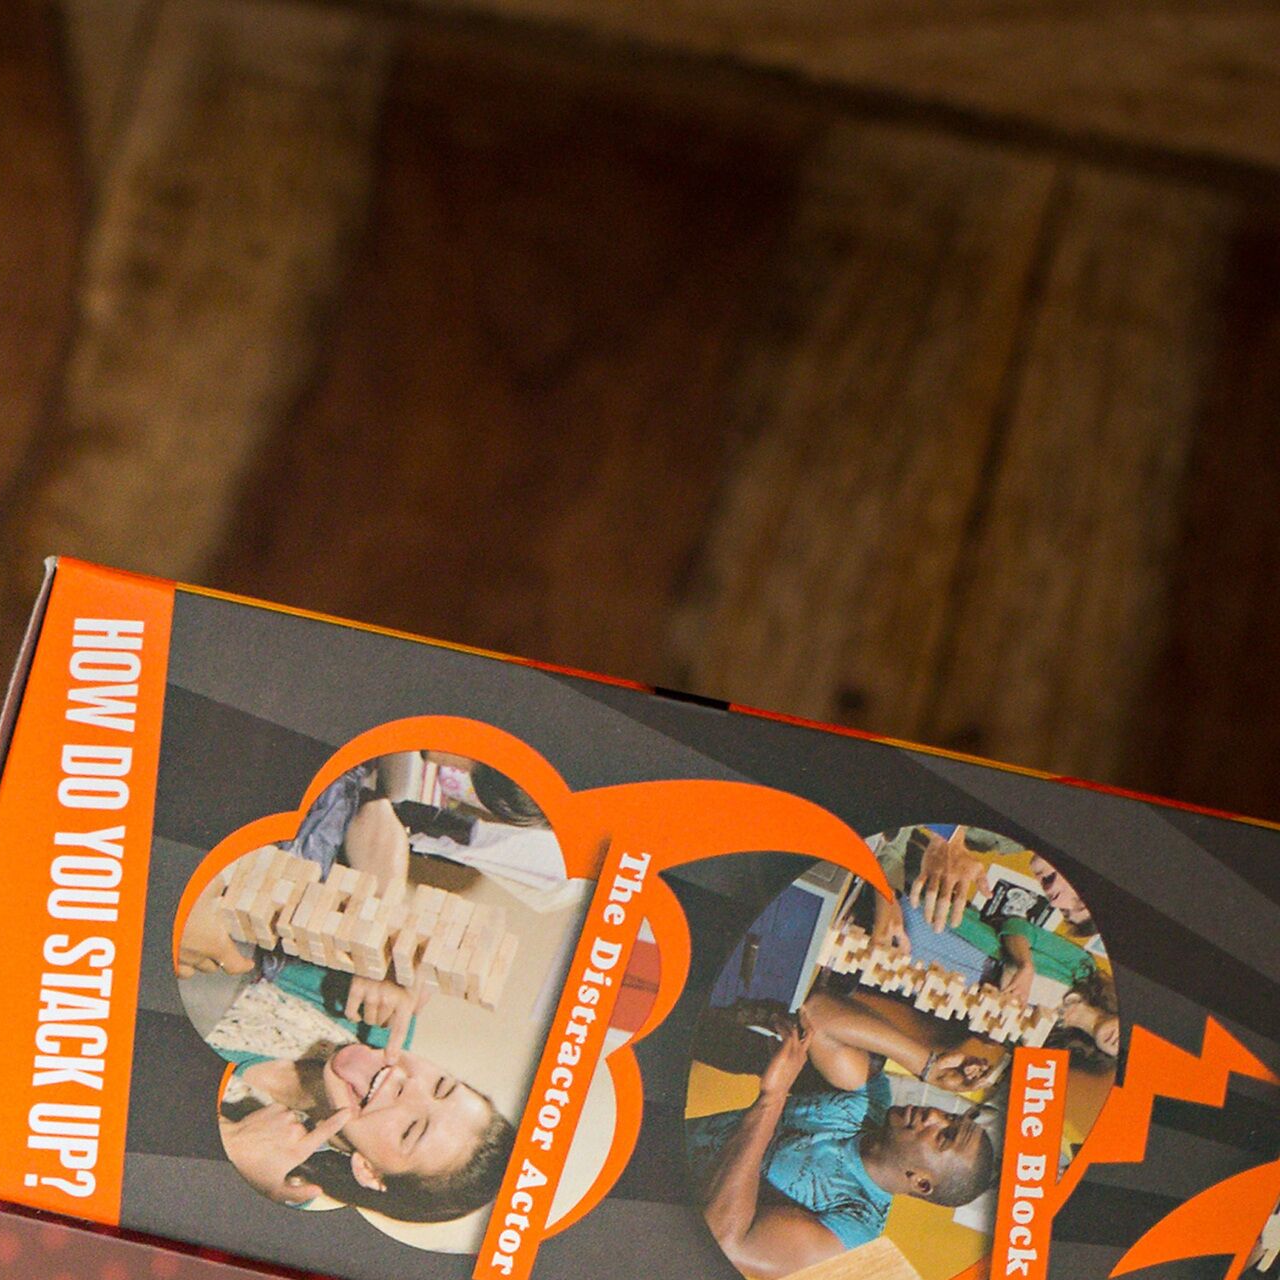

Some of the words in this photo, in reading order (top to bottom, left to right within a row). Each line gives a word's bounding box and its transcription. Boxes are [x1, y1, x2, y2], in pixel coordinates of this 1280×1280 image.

[69, 616, 146, 733] HOW
[57, 746, 133, 811] DO
[45, 824, 127, 923] YOU
[602, 851, 651, 928] The
[31, 934, 117, 1088] STACK
[530, 937, 623, 1154] Distractor
[1022, 1059, 1057, 1138] The
[24, 1104, 102, 1199] UP?
[490, 1167, 549, 1278] Actor
[1004, 1155, 1046, 1278] Block
